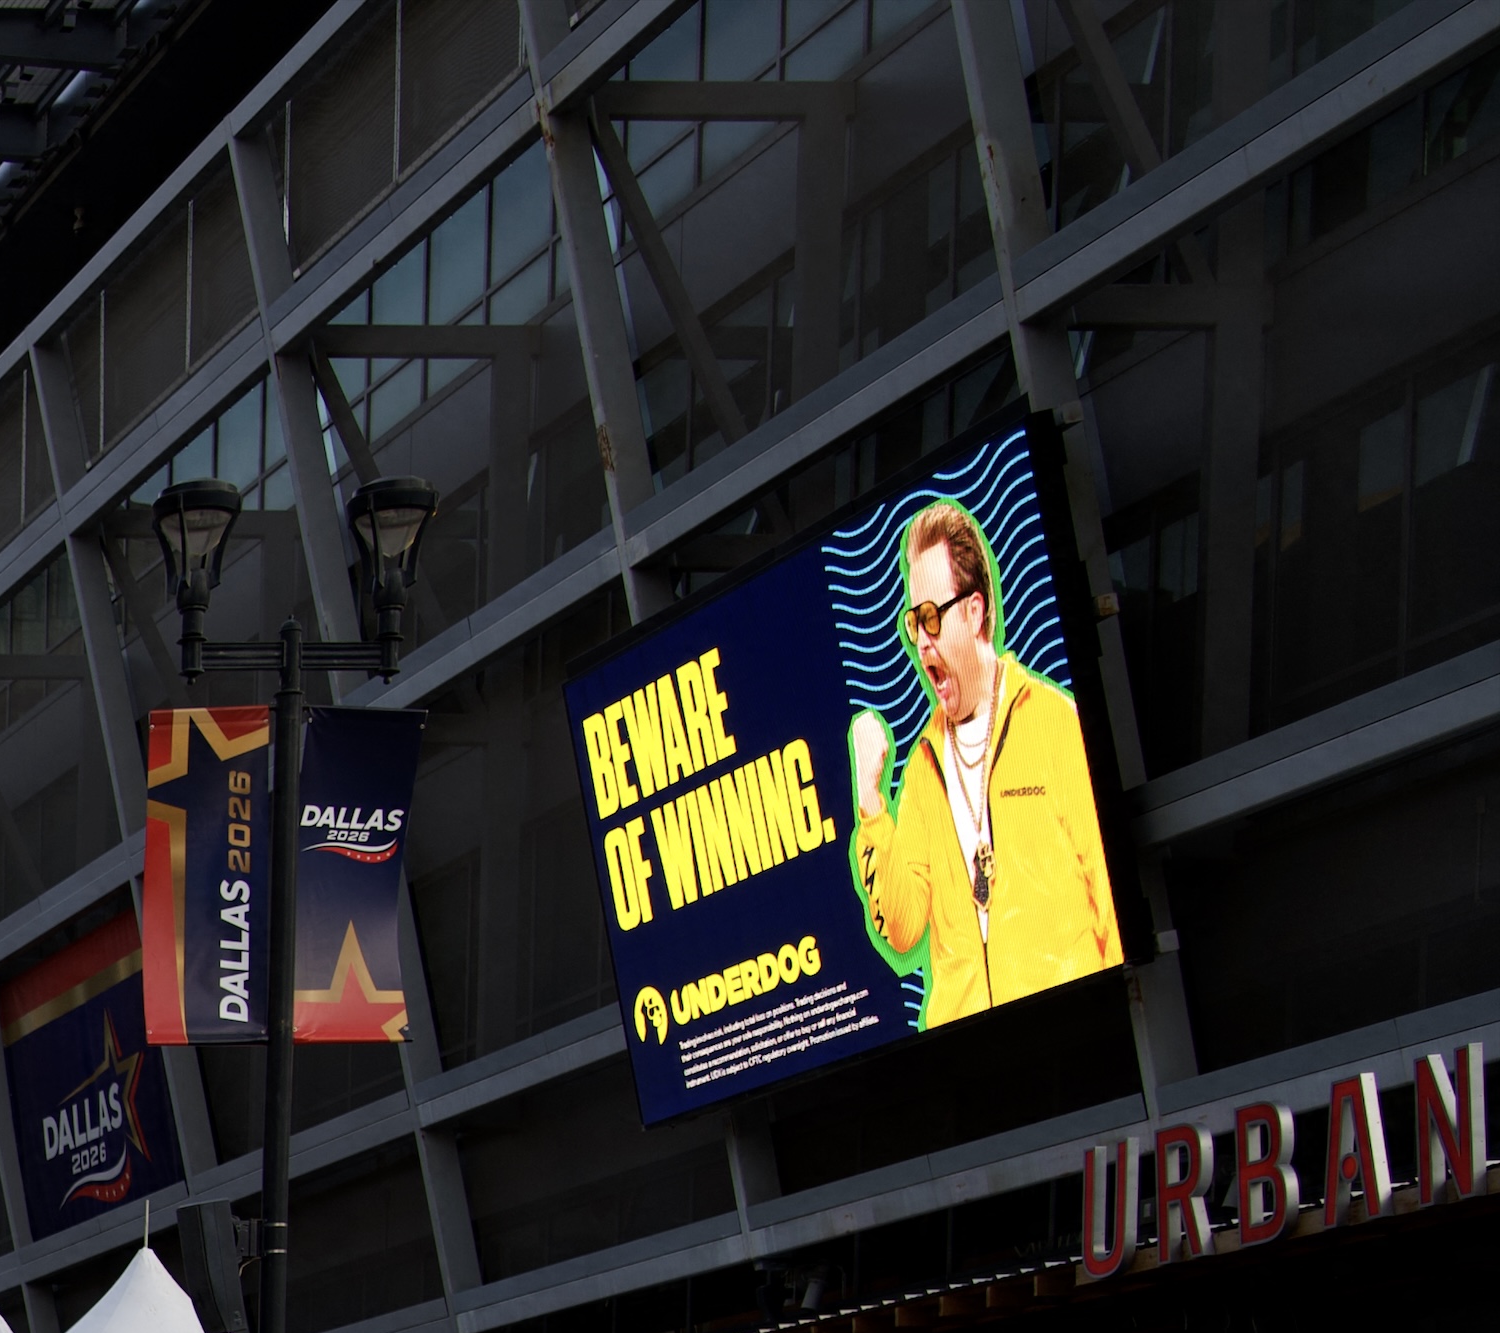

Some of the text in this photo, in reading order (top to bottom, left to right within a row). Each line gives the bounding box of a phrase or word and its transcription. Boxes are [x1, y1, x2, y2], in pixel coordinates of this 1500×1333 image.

[582, 647, 736, 819] BEWARE
[300, 805, 404, 833] DALLAS
[1000, 786, 1046, 798] UNDERDOG
[326, 829, 370, 843] 2026
[603, 738, 837, 932] OF WINNING.
[219, 770, 251, 1023] DALLAS 2026
[670, 935, 821, 1027] UNDERDOG
[41, 1082, 123, 1161] DALLAS
[71, 1142, 107, 1177] 2026
[1081, 1042, 1487, 1280] URBAN
